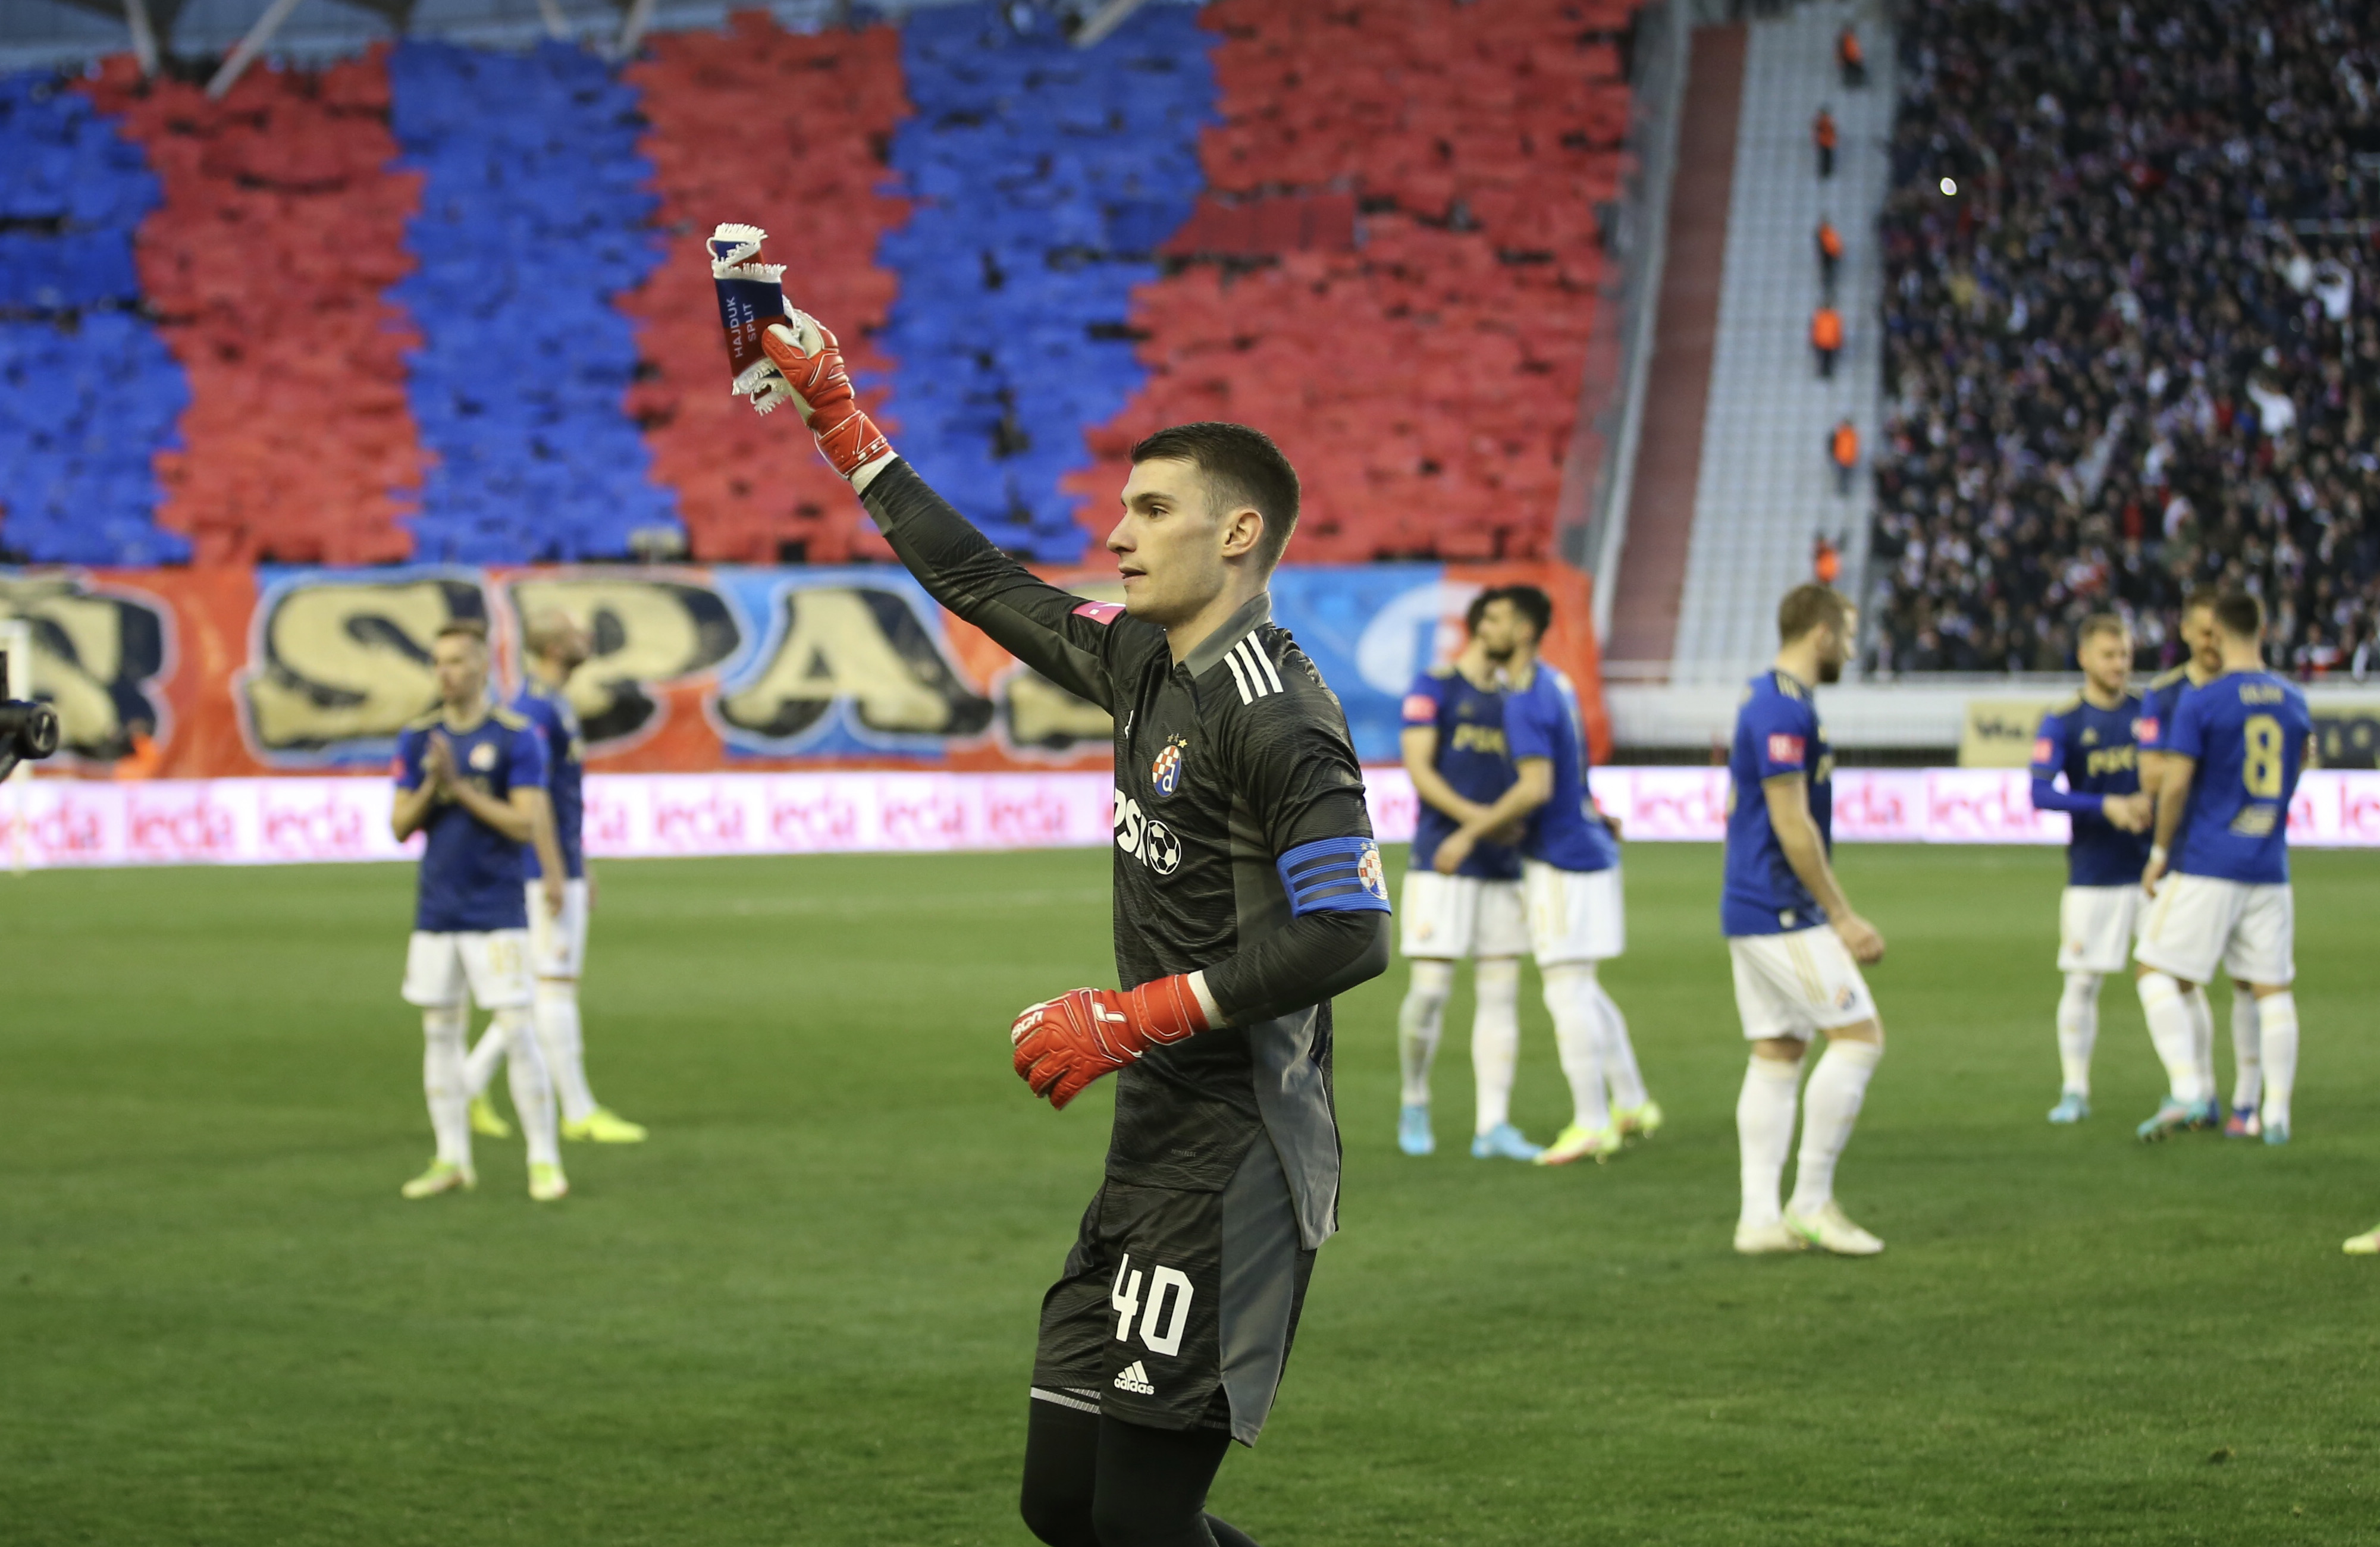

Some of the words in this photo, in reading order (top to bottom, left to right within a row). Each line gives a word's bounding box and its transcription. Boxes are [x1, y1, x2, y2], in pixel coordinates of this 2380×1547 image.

[726, 296, 743, 358] HAJDUK
[742, 303, 757, 341] SPLIT
[2242, 714, 2284, 798] 8
[1111, 1253, 1194, 1357] 40
[1114, 1377, 1155, 1395] adidas
